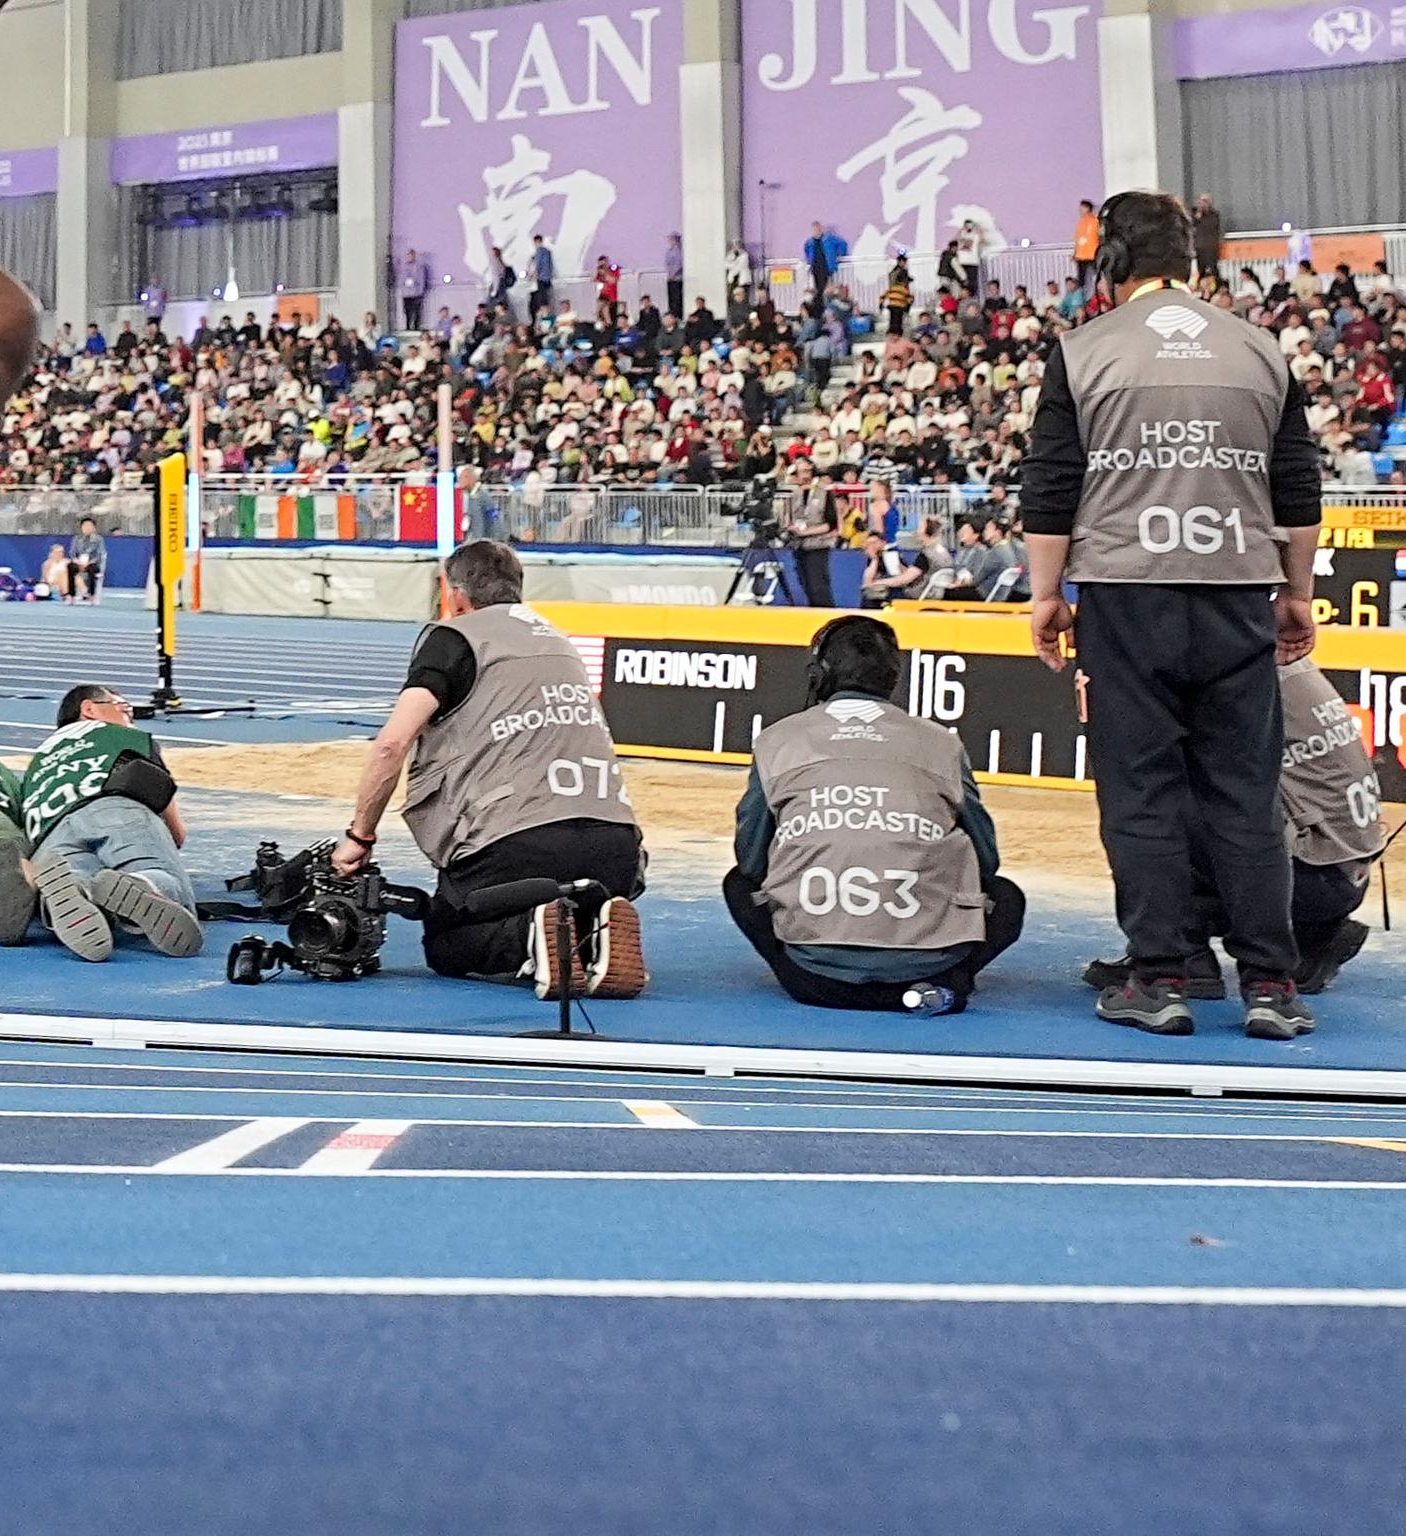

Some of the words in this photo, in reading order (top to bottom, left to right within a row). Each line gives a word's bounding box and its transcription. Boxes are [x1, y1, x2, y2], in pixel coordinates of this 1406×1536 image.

[421, 7, 661, 128] NAN
[458, 134, 617, 290] 南
[837, 86, 1007, 289] 京
[1140, 420, 1221, 444] HOST
[1138, 505, 1247, 554] 061
[614, 648, 757, 690] ROBINSON
[810, 785, 889, 807] HOST
[798, 866, 921, 919] 063
